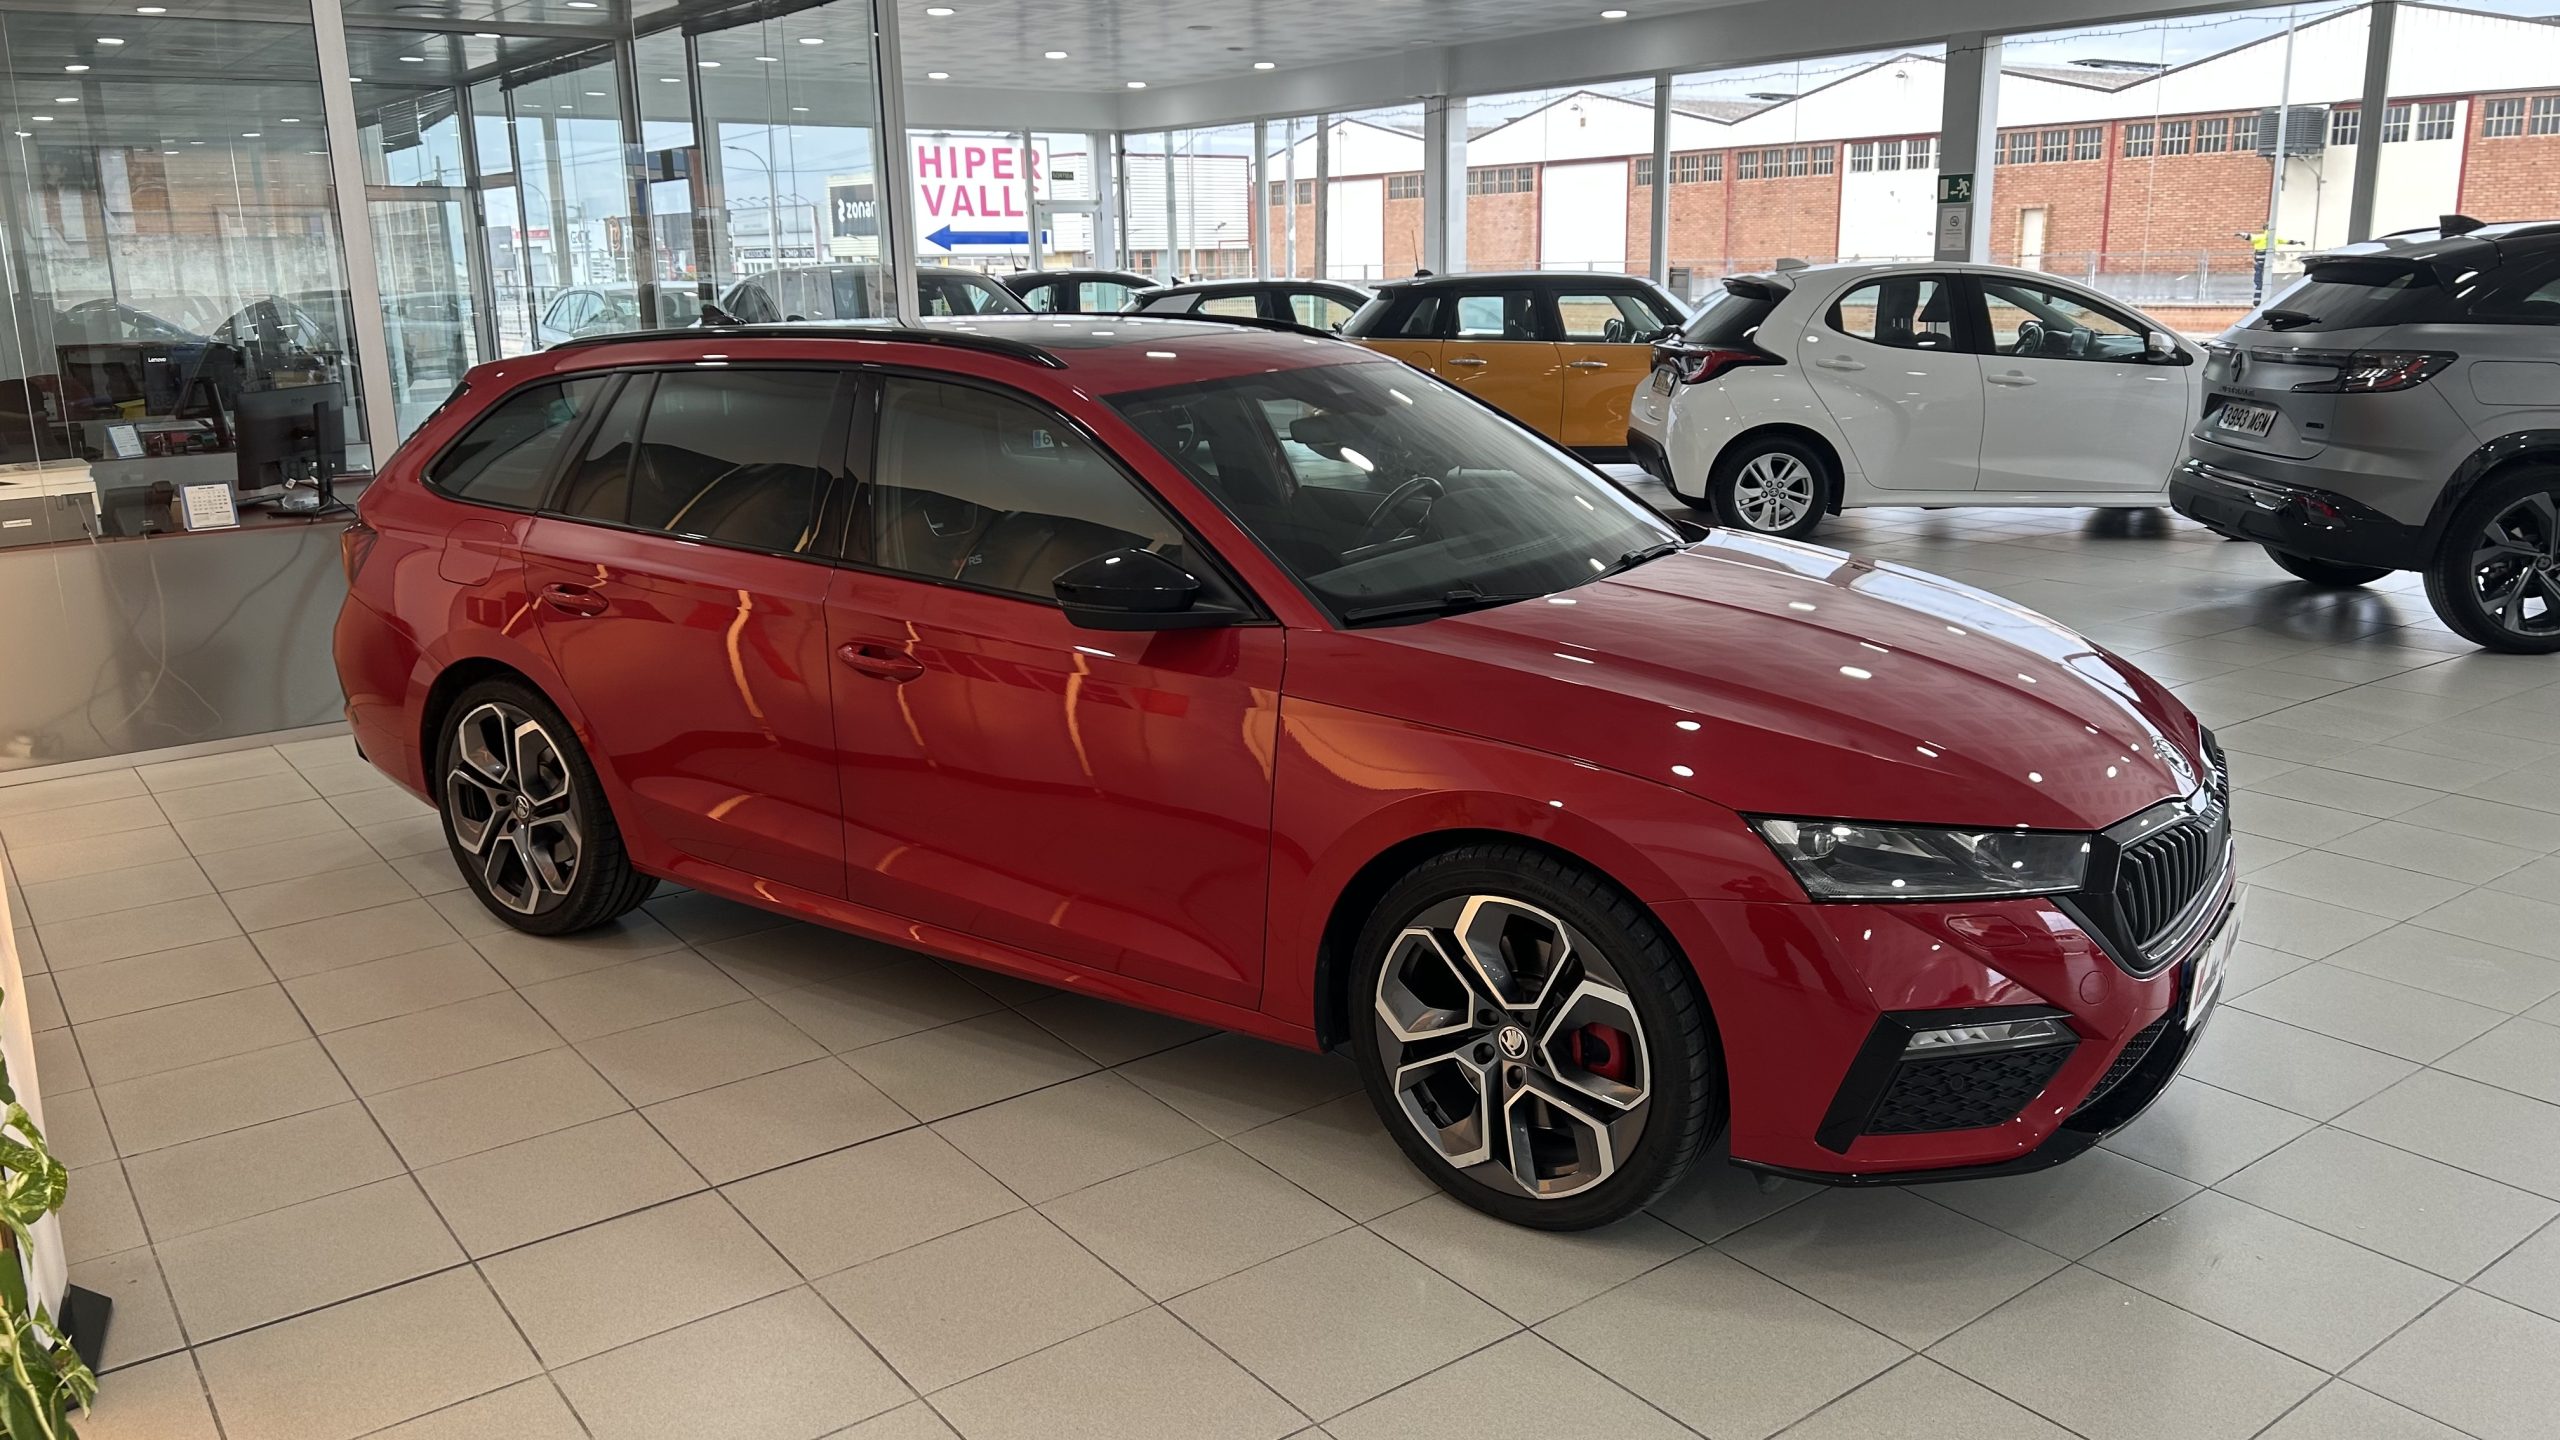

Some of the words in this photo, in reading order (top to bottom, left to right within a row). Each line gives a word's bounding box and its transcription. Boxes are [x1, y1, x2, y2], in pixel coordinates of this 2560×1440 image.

[918, 145, 1042, 179] HIPER
[921, 184, 1039, 217] VALL
[2223, 407, 2249, 428] 3993
[968, 554, 982, 565] RS
